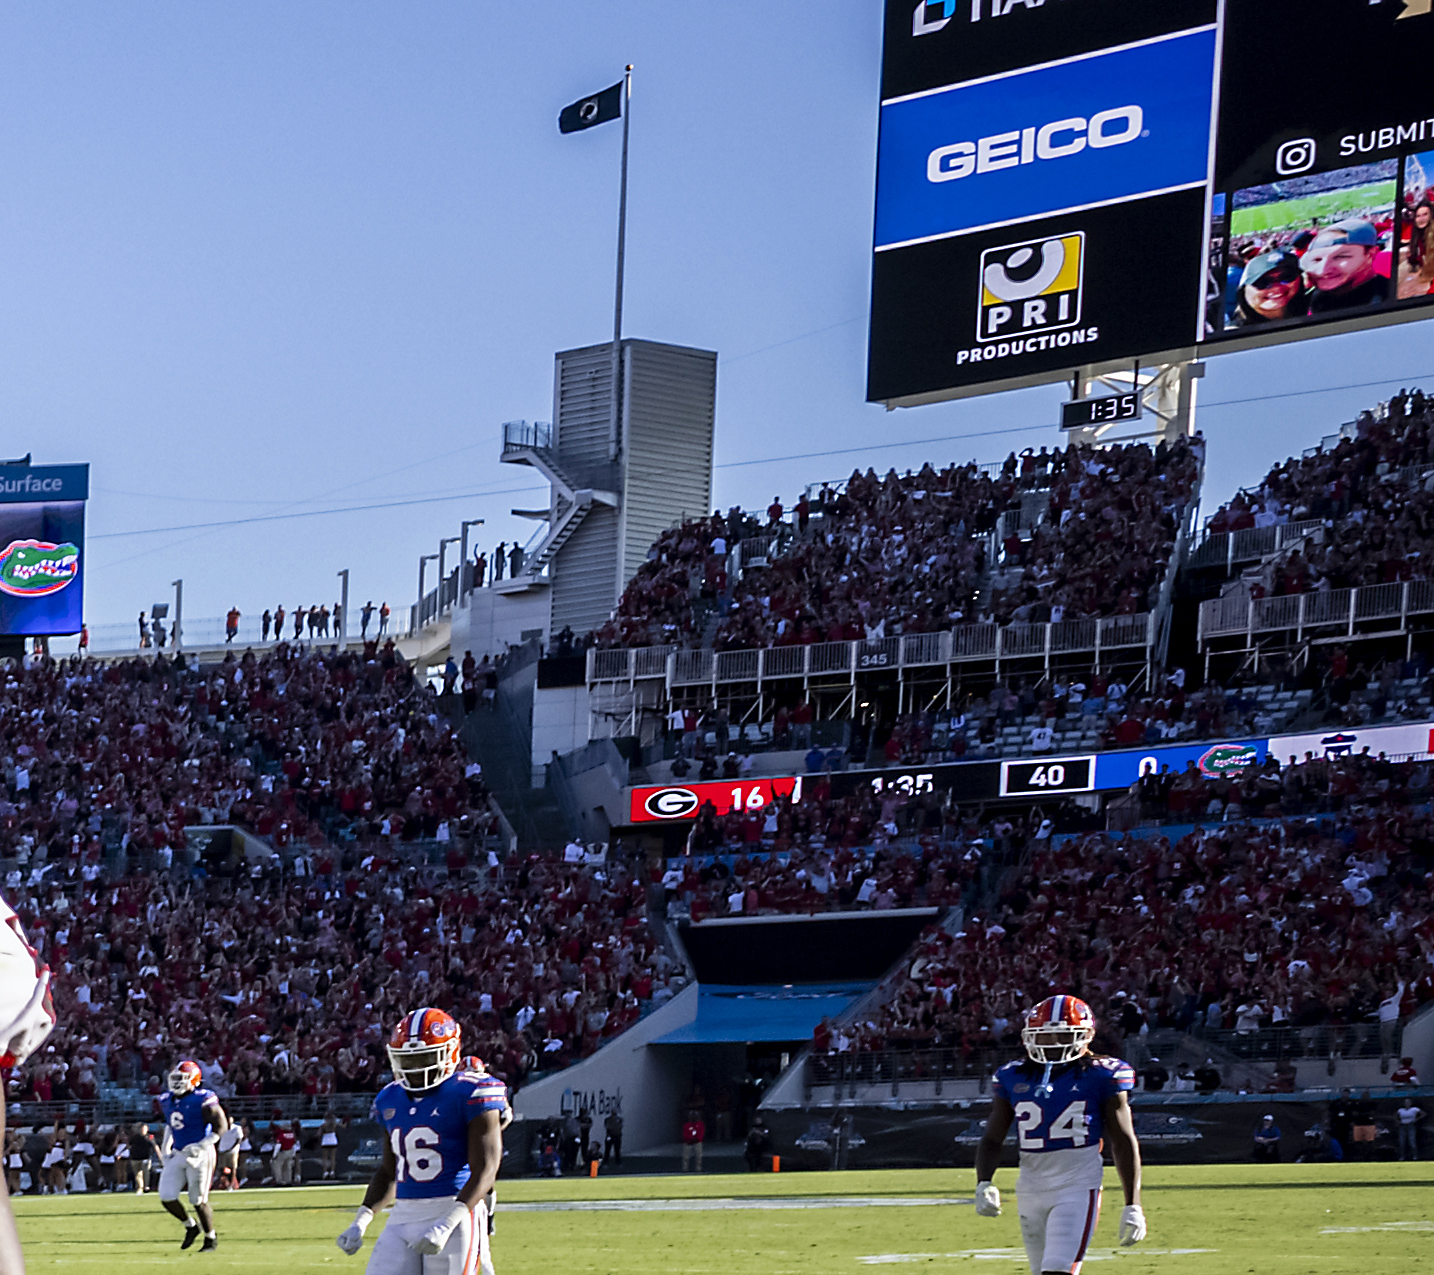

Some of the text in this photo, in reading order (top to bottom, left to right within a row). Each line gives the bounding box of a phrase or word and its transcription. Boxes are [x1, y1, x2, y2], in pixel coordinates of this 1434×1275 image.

[927, 105, 1143, 183] GEICO
[987, 294, 1069, 334] PRI
[957, 327, 1099, 366] PRODUCTIONS
[1090, 396, 1135, 420] 1:35
[1028, 765, 1065, 787] 40
[731, 786, 765, 811] 16
[1014, 1100, 1089, 1150] 24
[390, 1126, 443, 1182] 16
